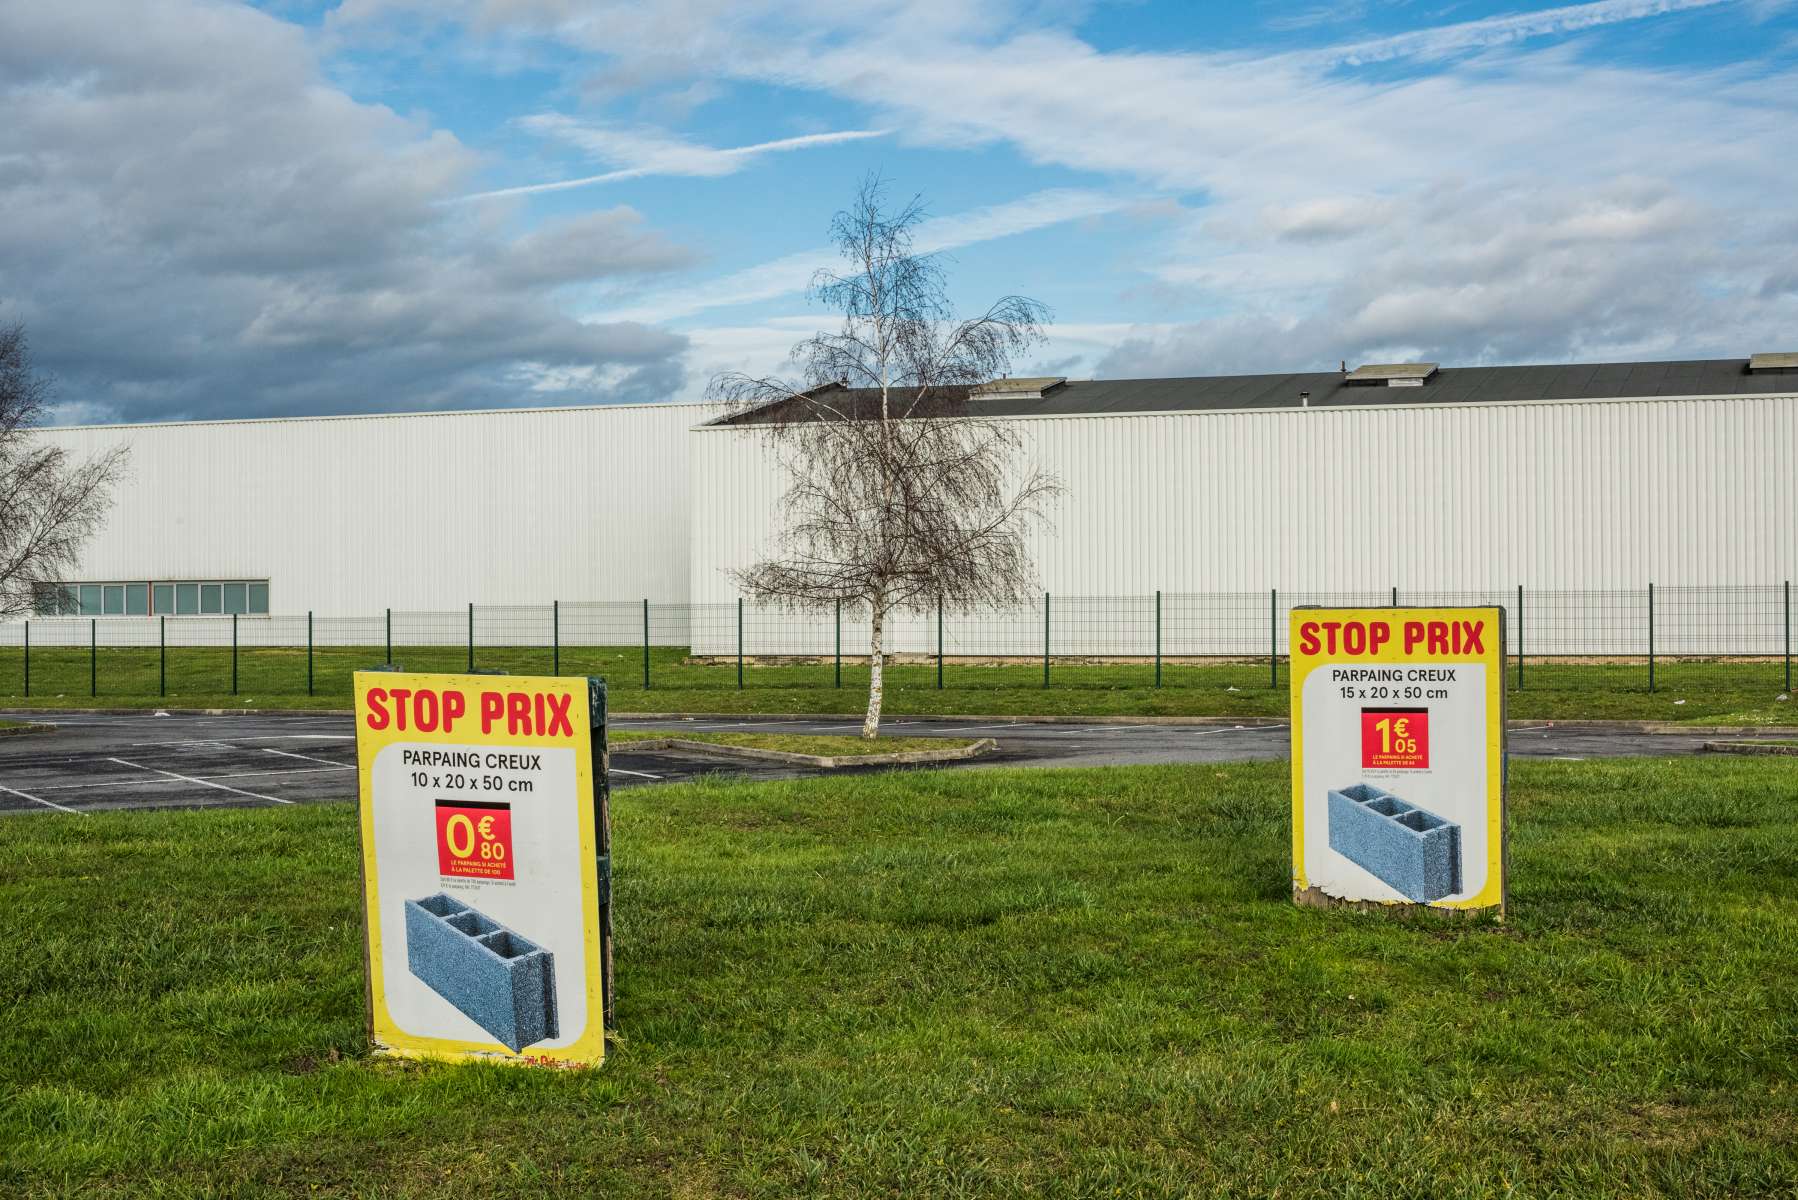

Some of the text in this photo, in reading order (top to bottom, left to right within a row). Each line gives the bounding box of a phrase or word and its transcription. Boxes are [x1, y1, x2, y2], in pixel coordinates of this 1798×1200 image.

[1299, 620, 1485, 656] STOP PRIX
[1332, 669, 1457, 682] PARPAING CREUX
[1340, 686, 1448, 699] 15 x 20 x 50 cm
[366, 687, 574, 737] STOP PRIX
[1375, 718, 1390, 753] 1
[1394, 738, 1417, 753] 05
[403, 749, 542, 771] PARPAING CREUX
[411, 771, 533, 792] 10 x 20 x 50 cm
[446, 813, 475, 859] 0
[480, 841, 505, 860] 80
